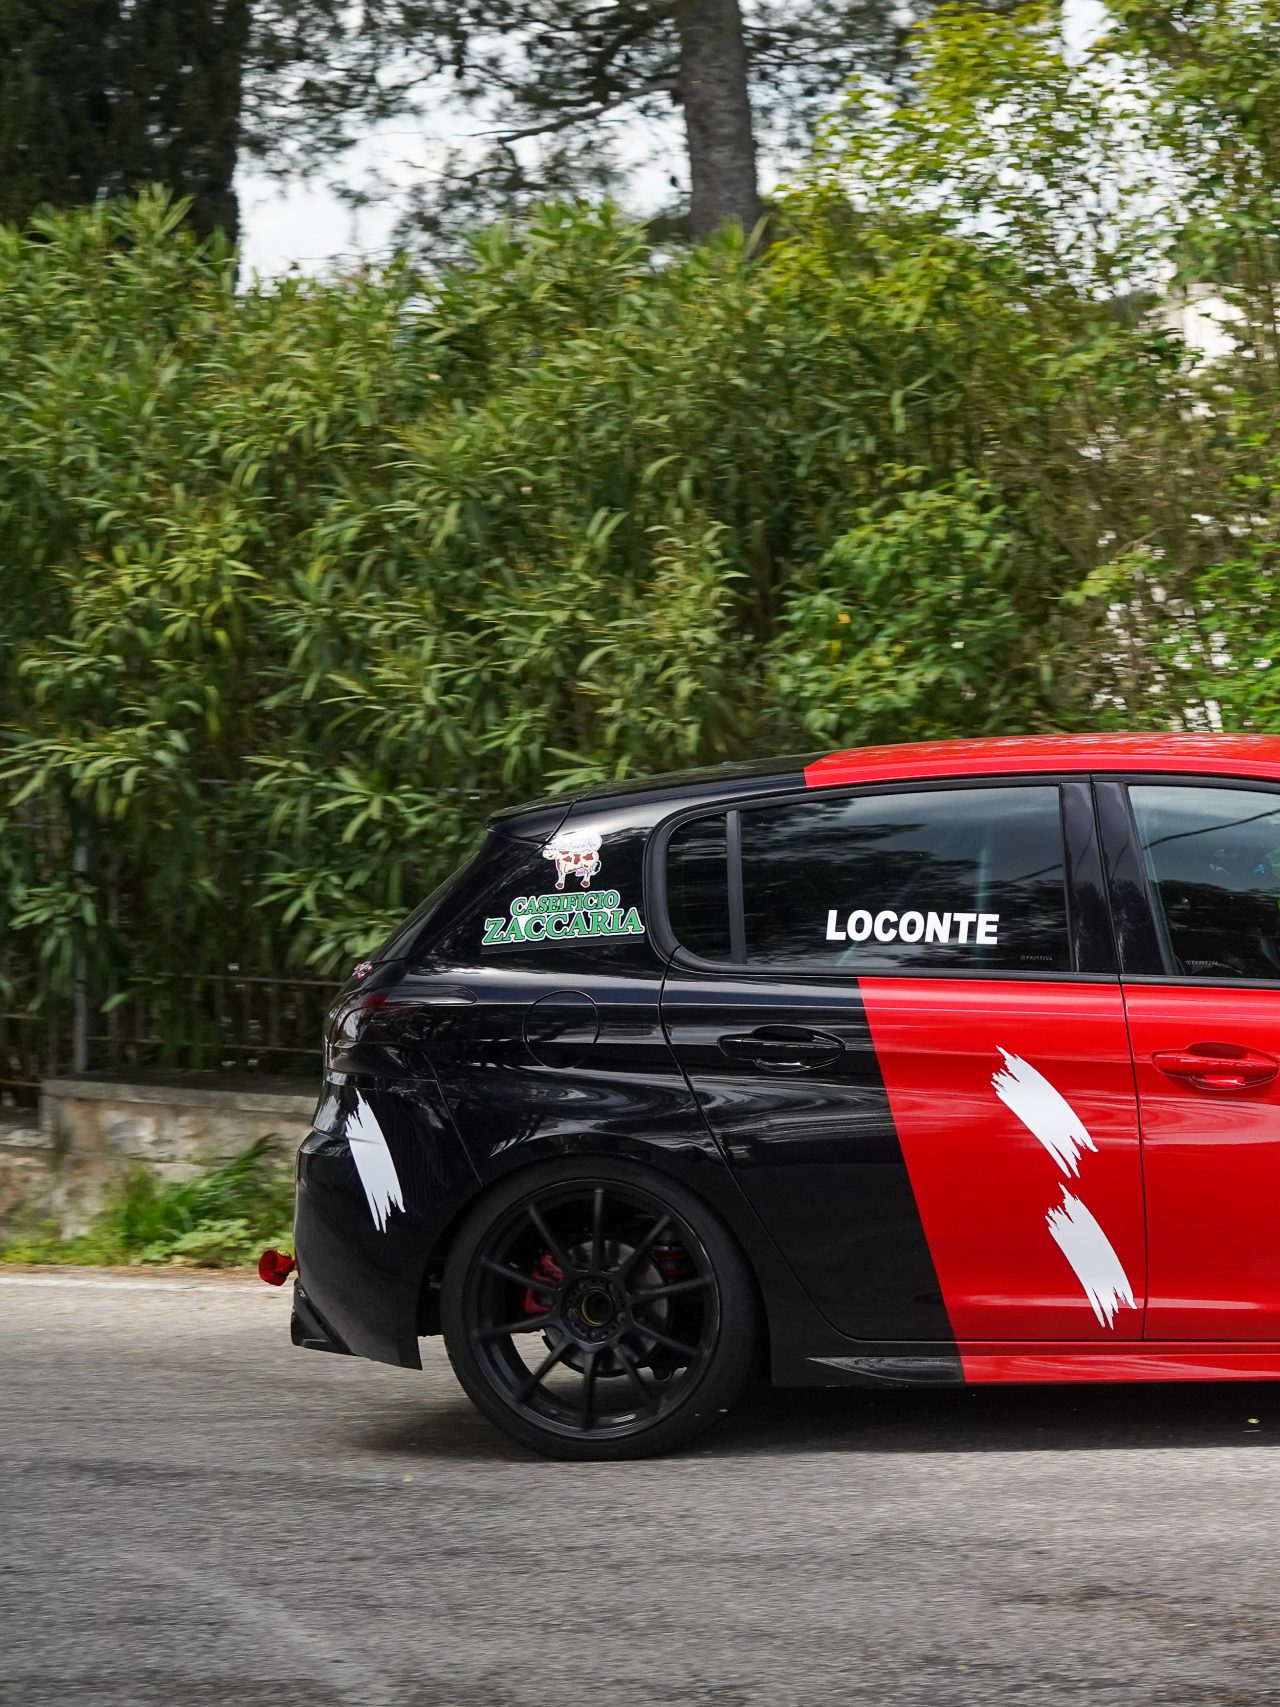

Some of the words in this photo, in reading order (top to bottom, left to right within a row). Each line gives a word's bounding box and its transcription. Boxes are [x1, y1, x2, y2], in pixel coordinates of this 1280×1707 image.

[511, 890, 620, 916] CASEIFICIO
[482, 907, 645, 945] ZACCARIA
[825, 909, 999, 945] LOCONTE
